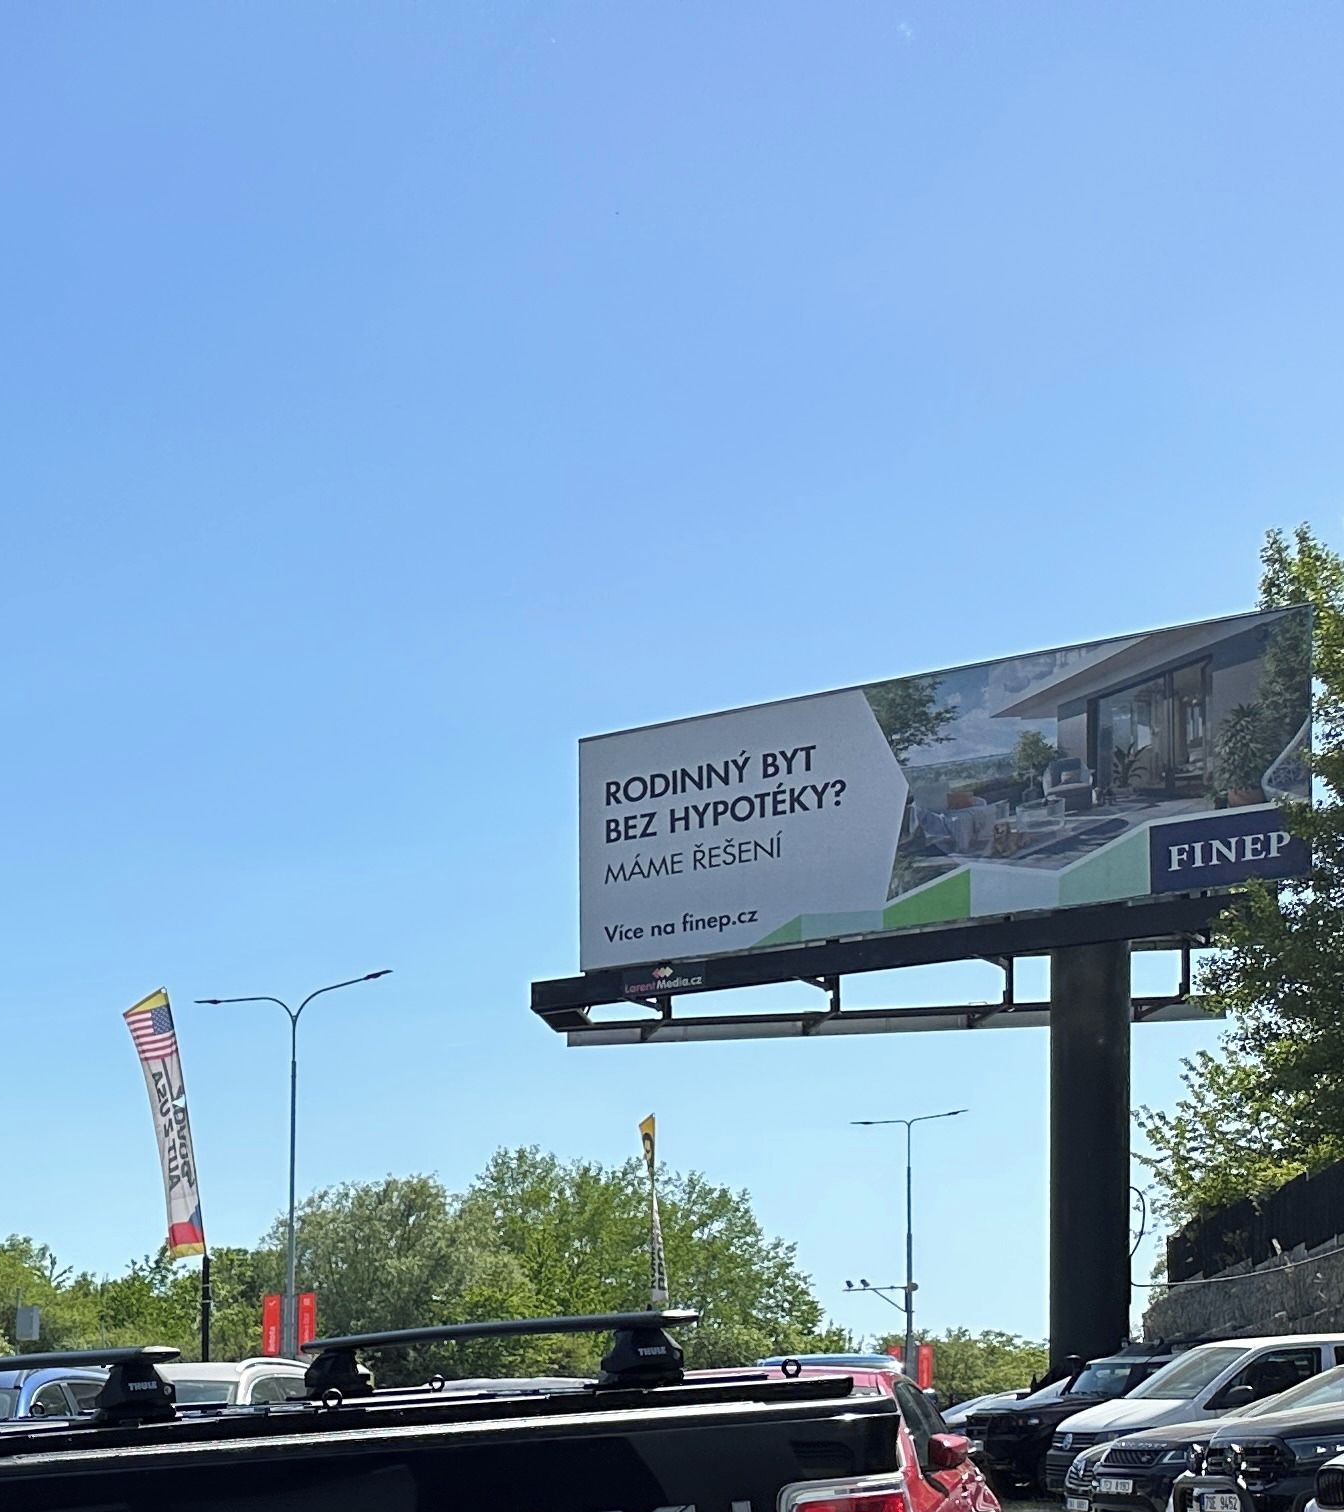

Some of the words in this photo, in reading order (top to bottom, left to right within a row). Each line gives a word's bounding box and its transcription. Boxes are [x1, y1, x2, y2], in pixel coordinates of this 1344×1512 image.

[605, 750, 751, 806] RODINNÝ
[762, 745, 816, 779] BYT
[605, 811, 658, 844] BEZ
[670, 779, 847, 833] HYPOTÉKY?
[604, 853, 684, 885] MÁME
[693, 830, 783, 871] ŘEŠENÍ
[1167, 831, 1291, 872] FINEP
[604, 924, 644, 943] Více
[651, 920, 675, 937] na
[682, 910, 759, 933] finep.cz
[128, 1381, 158, 1391] THULE
